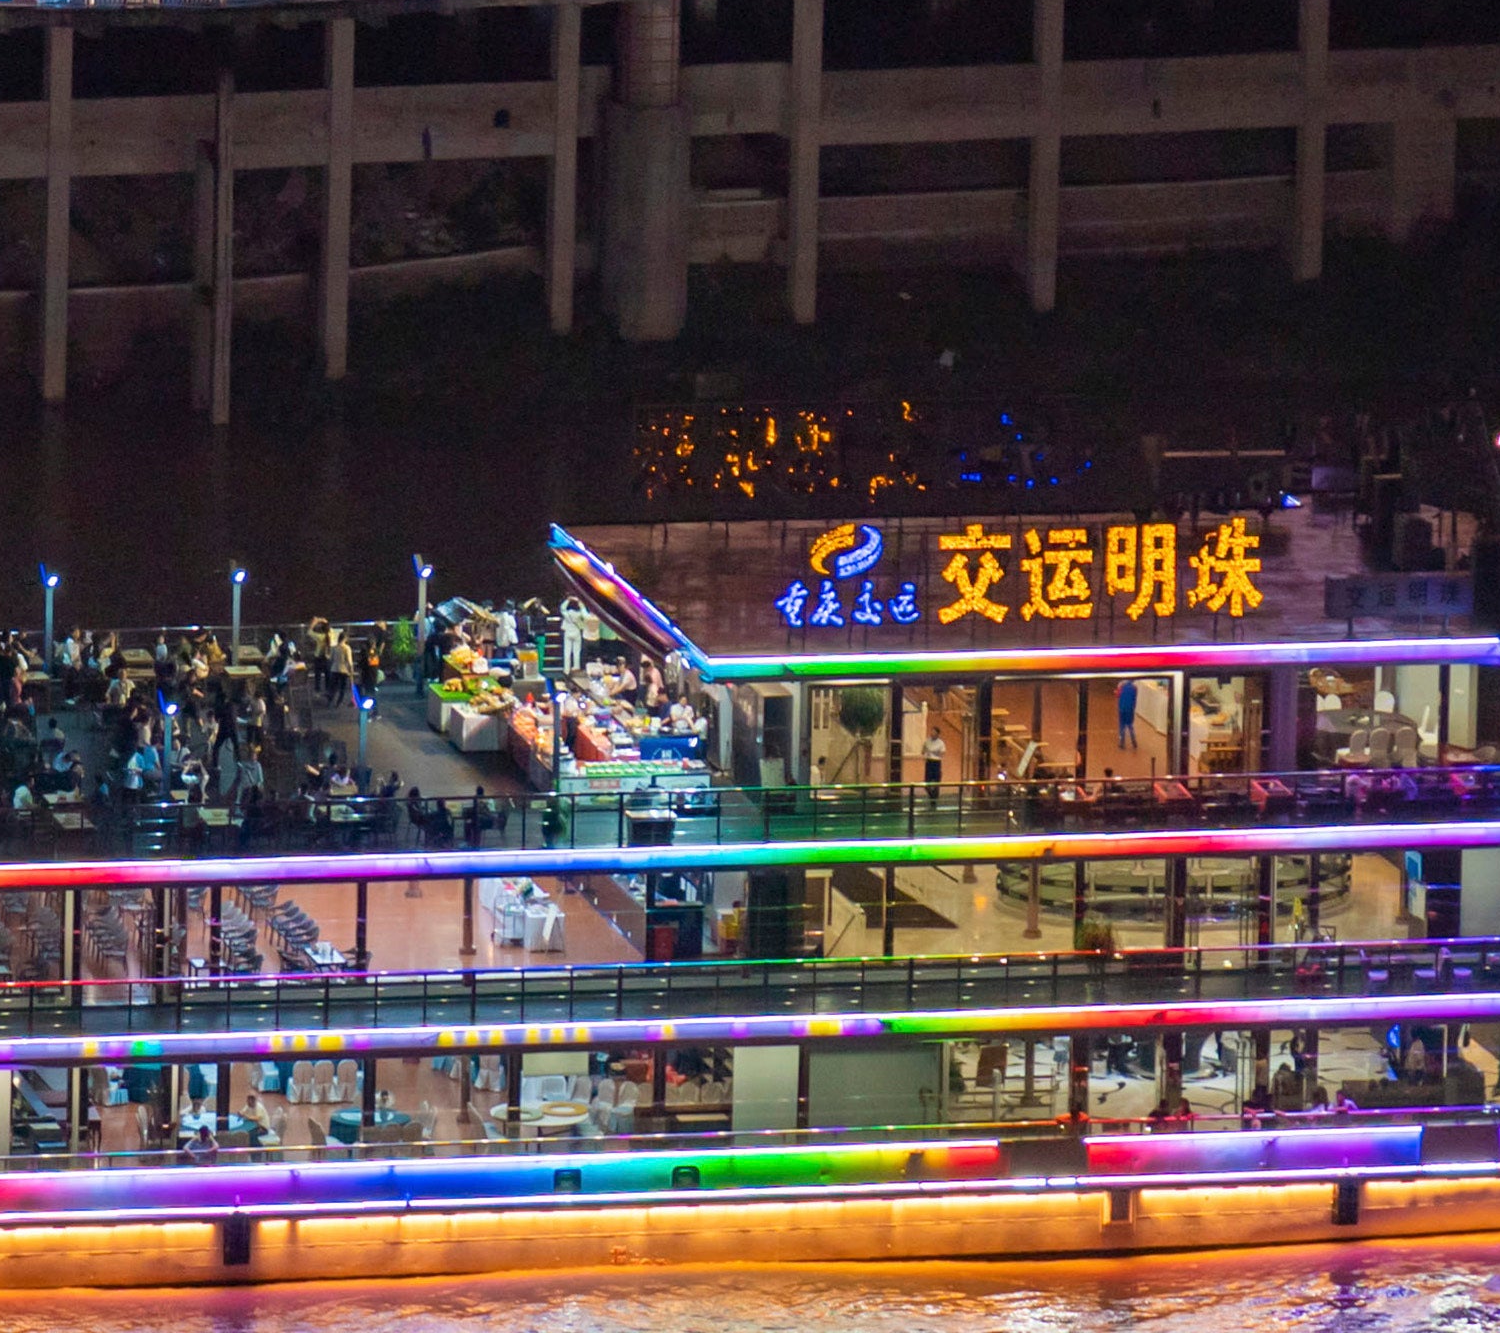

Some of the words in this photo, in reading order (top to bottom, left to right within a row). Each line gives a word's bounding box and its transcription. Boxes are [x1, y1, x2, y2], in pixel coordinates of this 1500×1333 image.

[775, 579, 922, 627] 重庆交运
[939, 517, 1264, 623] 交运明珠
